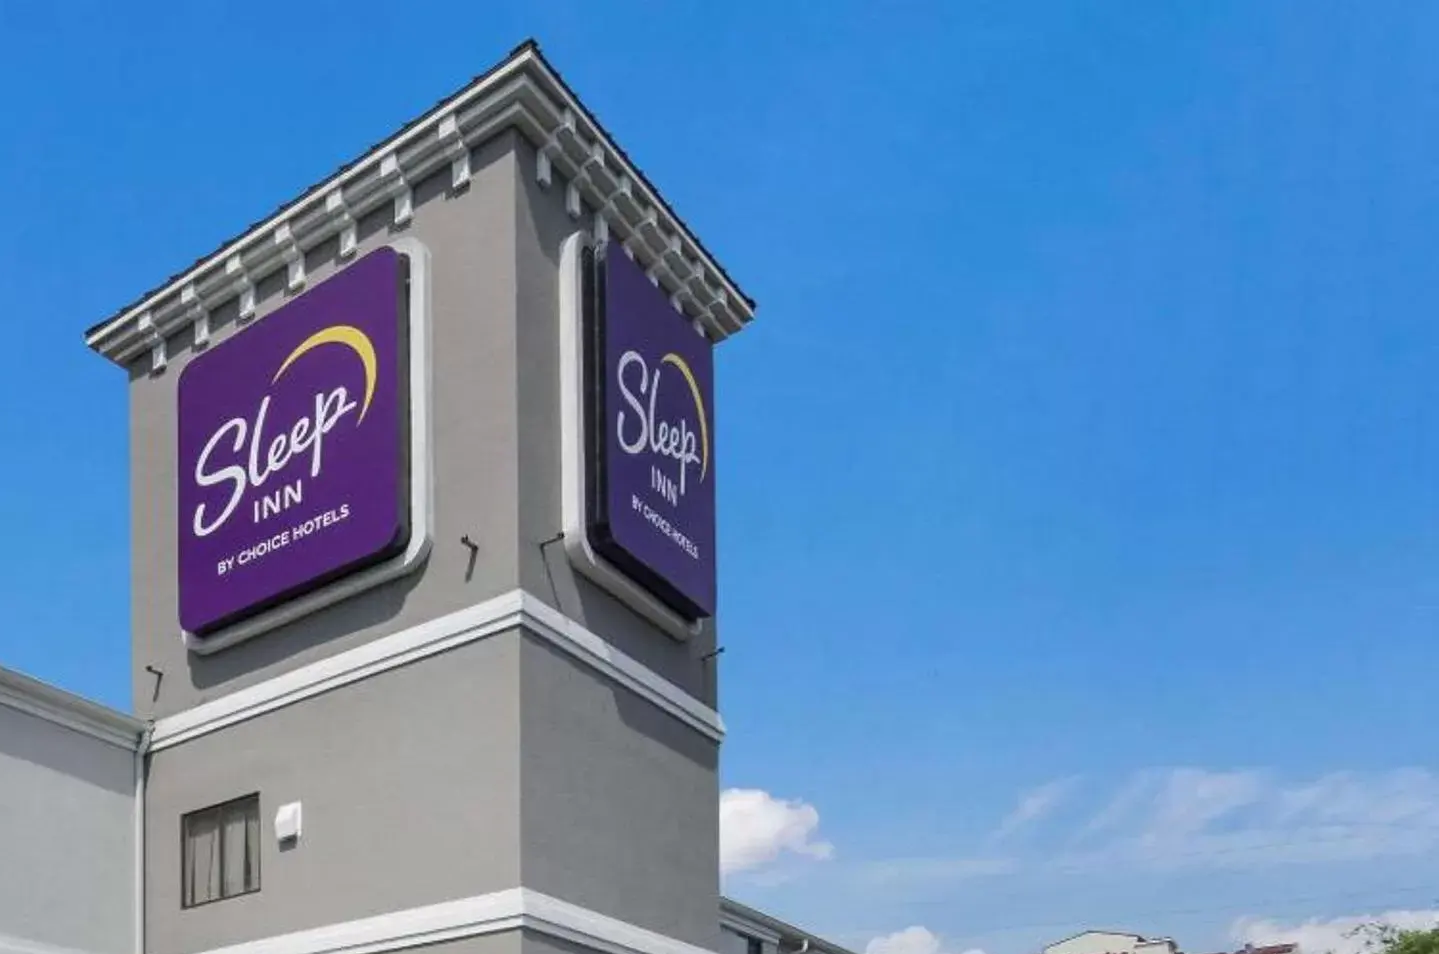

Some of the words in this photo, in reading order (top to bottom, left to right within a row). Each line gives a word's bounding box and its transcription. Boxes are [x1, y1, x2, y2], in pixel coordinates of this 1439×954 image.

[617, 350, 701, 496] Sleep
[193, 387, 357, 536] Sleep
[651, 465, 678, 507] INN
[253, 479, 303, 523] INN
[217, 556, 235, 576] BY
[237, 531, 290, 565] CHOICE
[292, 503, 350, 541] HOTELS
